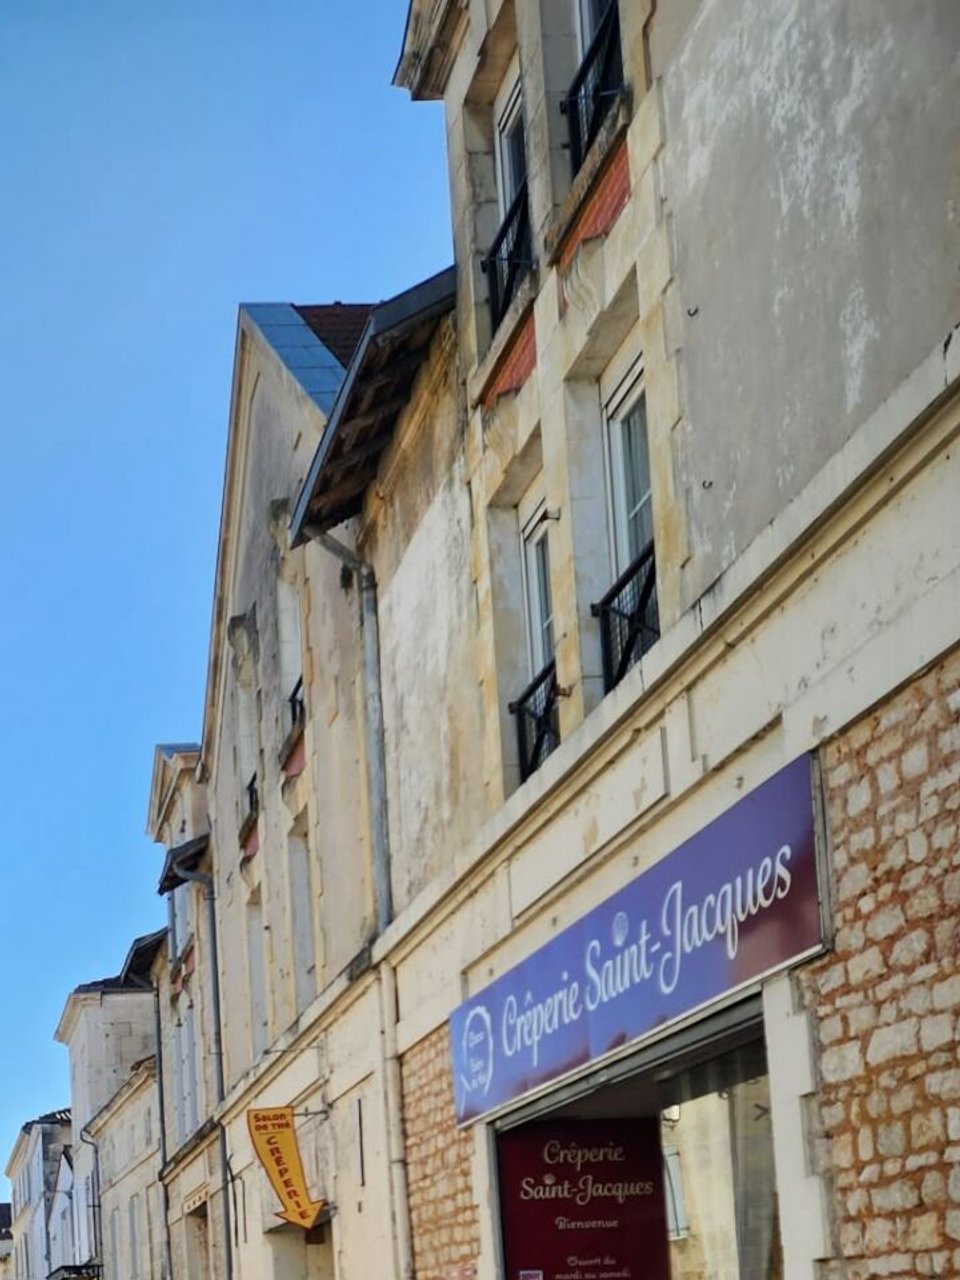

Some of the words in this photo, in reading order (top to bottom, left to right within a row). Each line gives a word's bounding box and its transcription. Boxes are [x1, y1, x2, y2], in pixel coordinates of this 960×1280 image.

[502, 972, 583, 1067] Crêperie
[584, 844, 793, 1013] Saint-Jacques
[544, 1140, 625, 1171] Crêperie
[520, 1174, 653, 1206] Saint-Jacques
